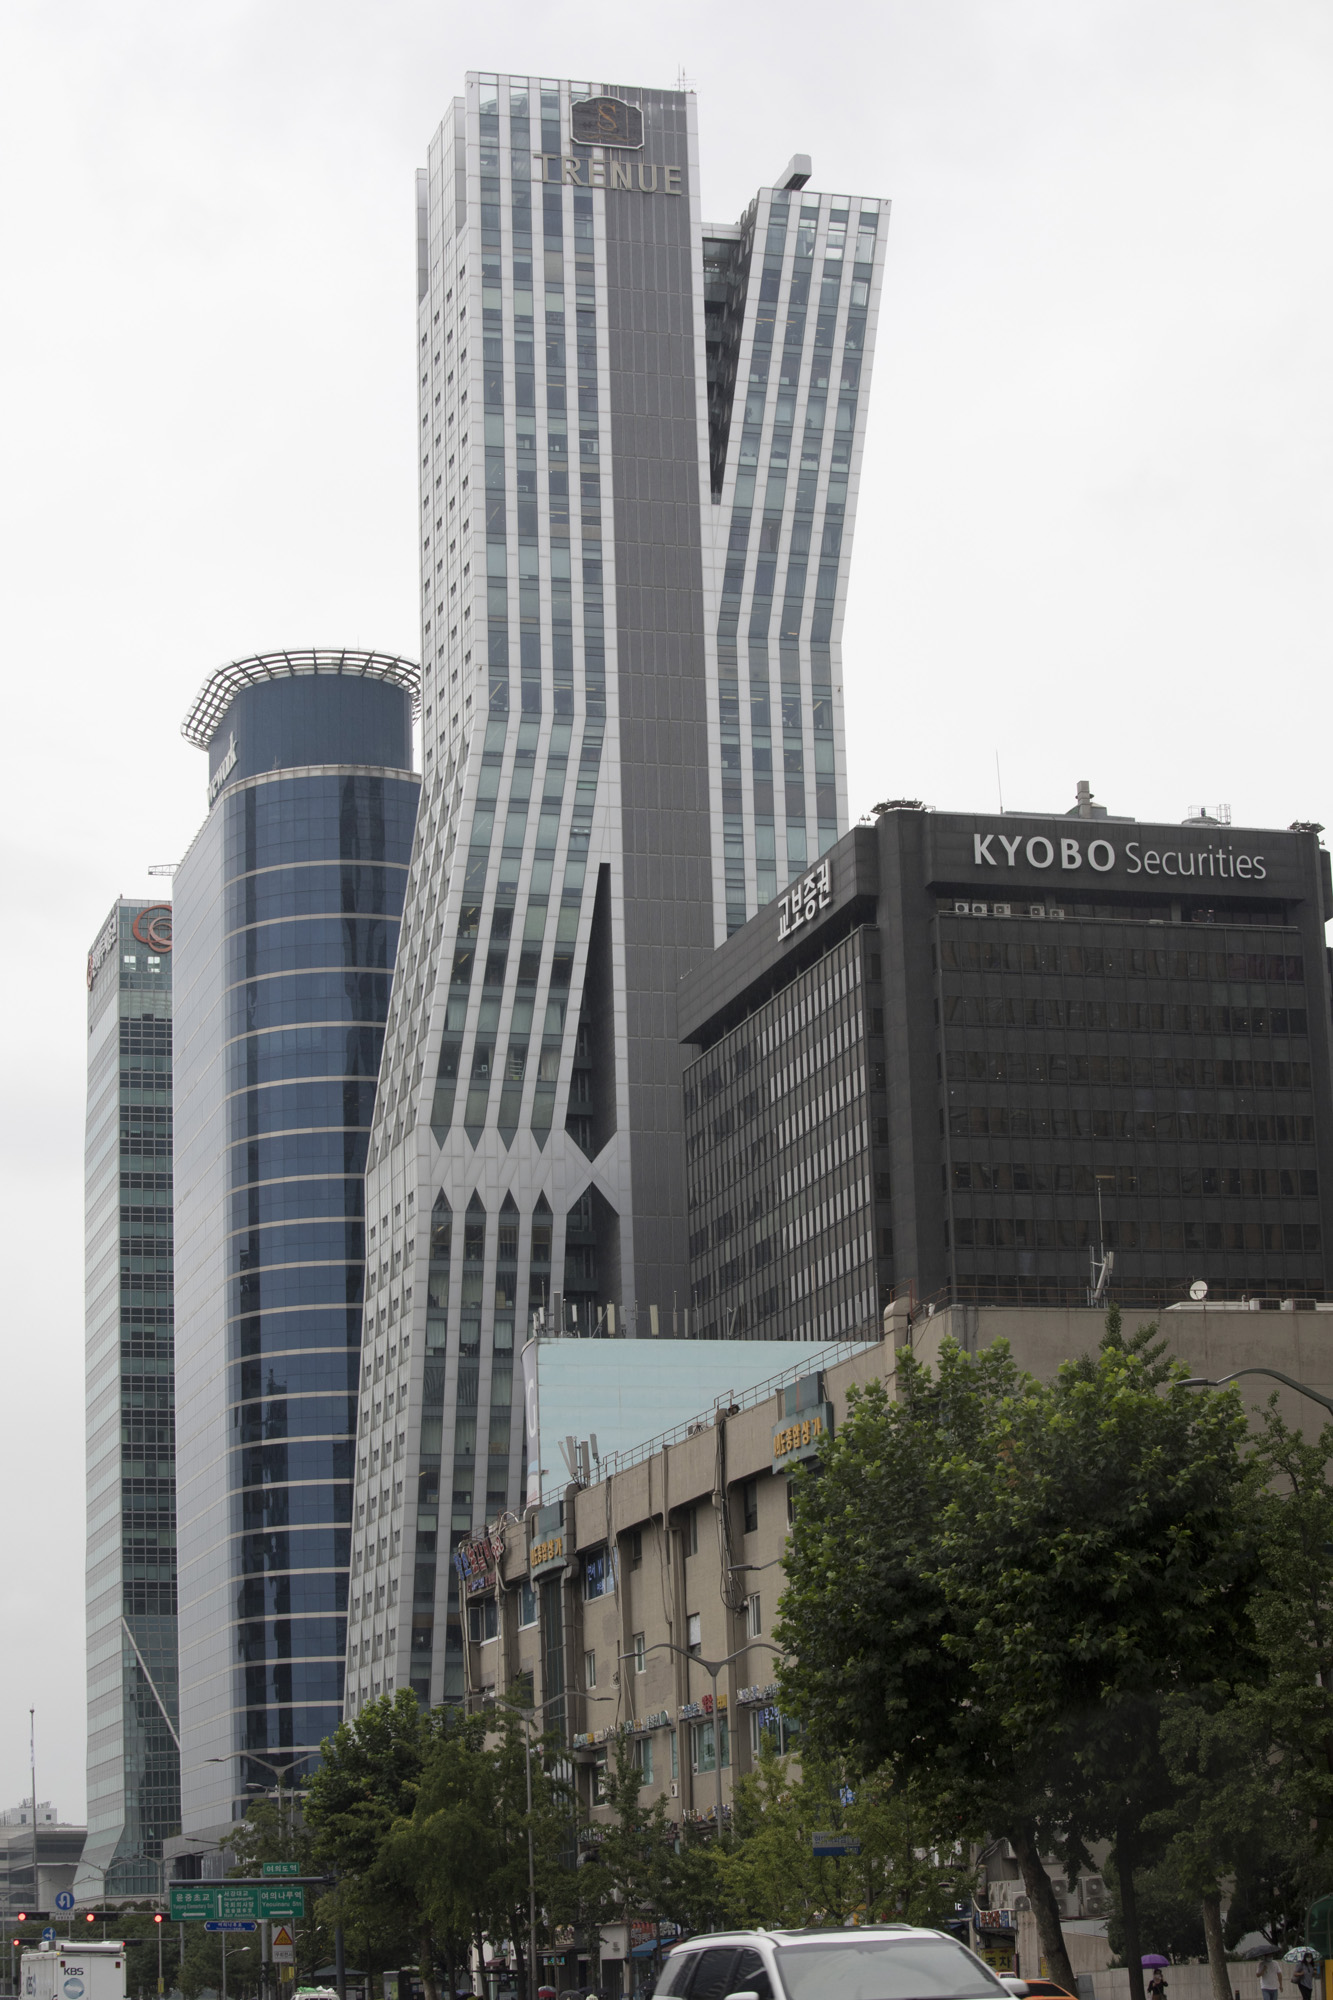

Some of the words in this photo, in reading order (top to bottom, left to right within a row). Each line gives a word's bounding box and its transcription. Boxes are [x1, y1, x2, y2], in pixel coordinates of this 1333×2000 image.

[533, 153, 683, 195] TRENUE
[973, 833, 1116, 872] KYOBO
[1125, 841, 1267, 880] Securities
[777, 858, 830, 942] 교보증권
[266, 1864, 297, 1872] 여의도역
[261, 1891, 302, 1900] 여의나루역
[985, 1956, 1011, 1969] 주차
[63, 1967, 84, 1976] KBS
